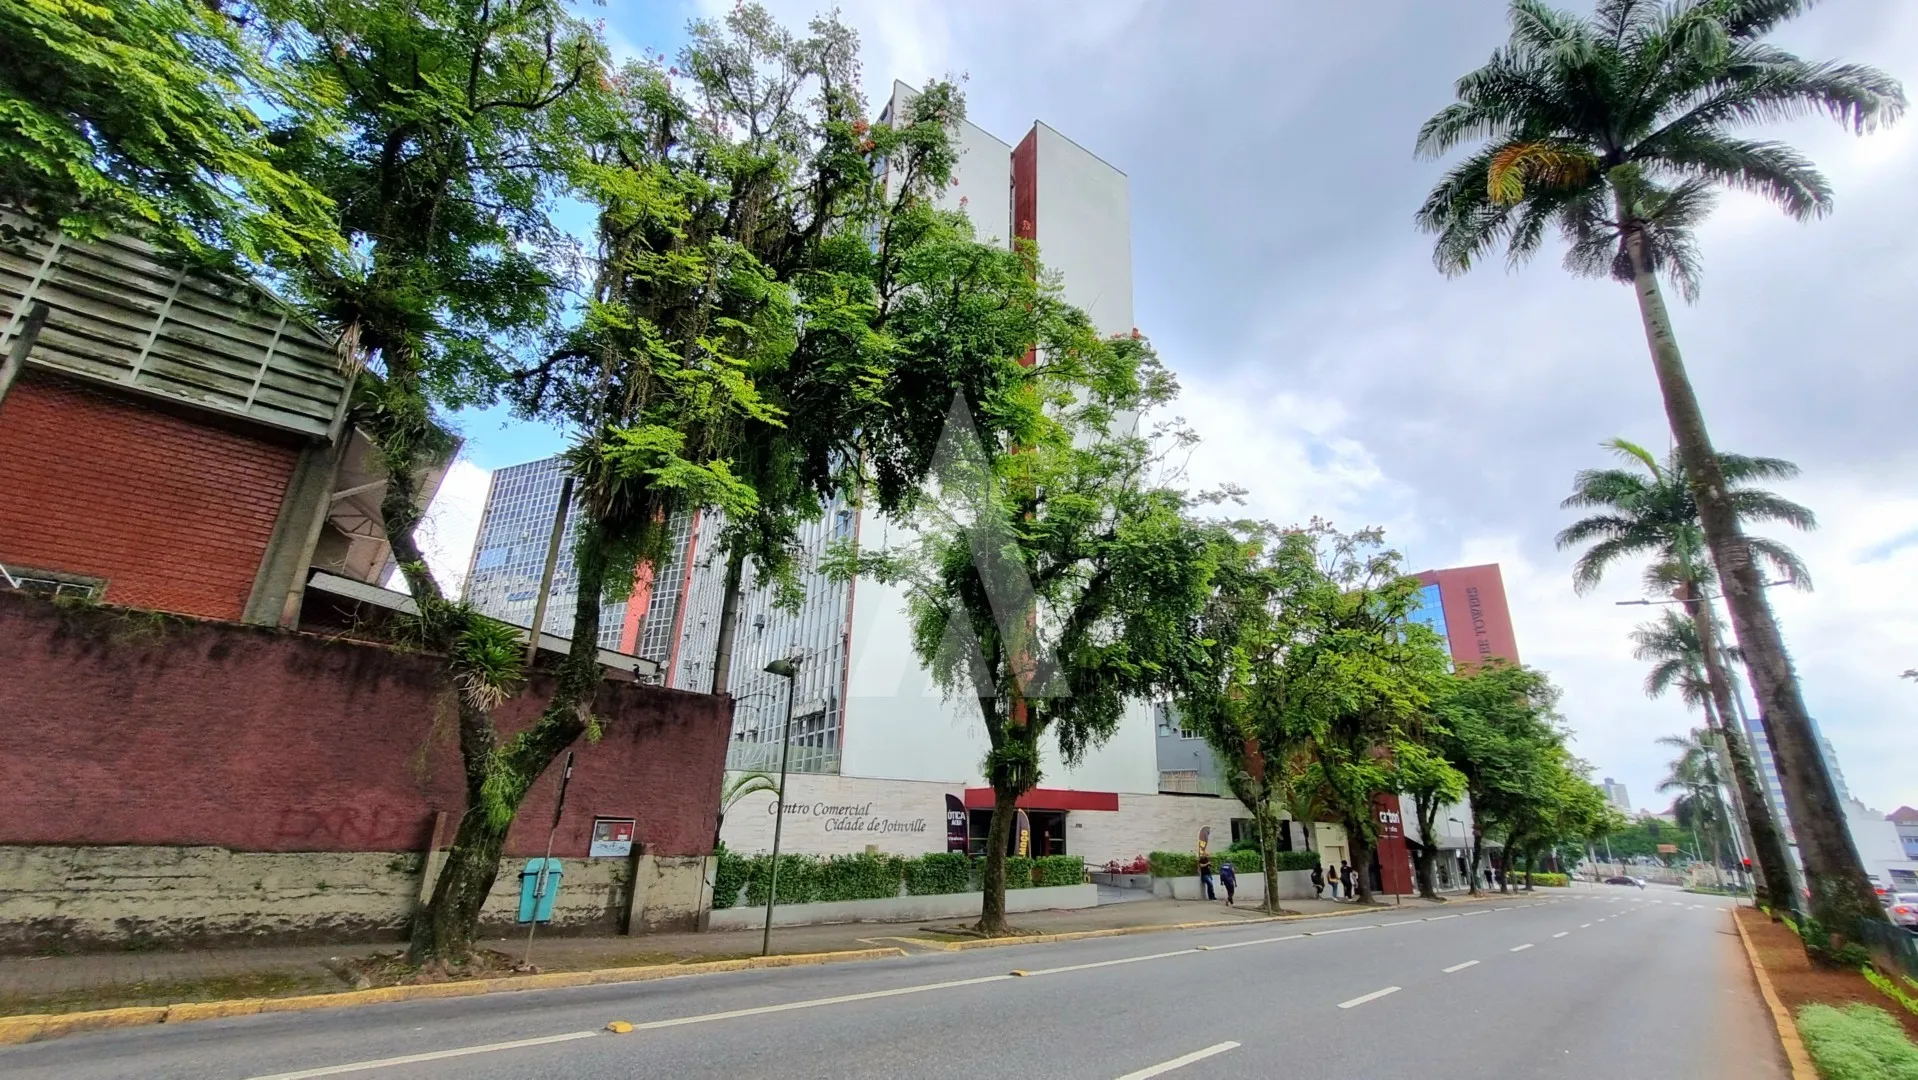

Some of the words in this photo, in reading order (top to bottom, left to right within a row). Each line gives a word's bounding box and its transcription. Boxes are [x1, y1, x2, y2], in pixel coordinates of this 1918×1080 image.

[1466, 586, 1487, 637] TOWERS
[768, 801, 809, 815] Cntro
[813, 802, 872, 816] Comercial
[948, 809, 966, 820] ÓTICA
[825, 817, 864, 831] Cidade
[867, 817, 880, 831] de
[880, 818, 926, 833] Joinville
[1018, 829, 1029, 856] MOÇO
